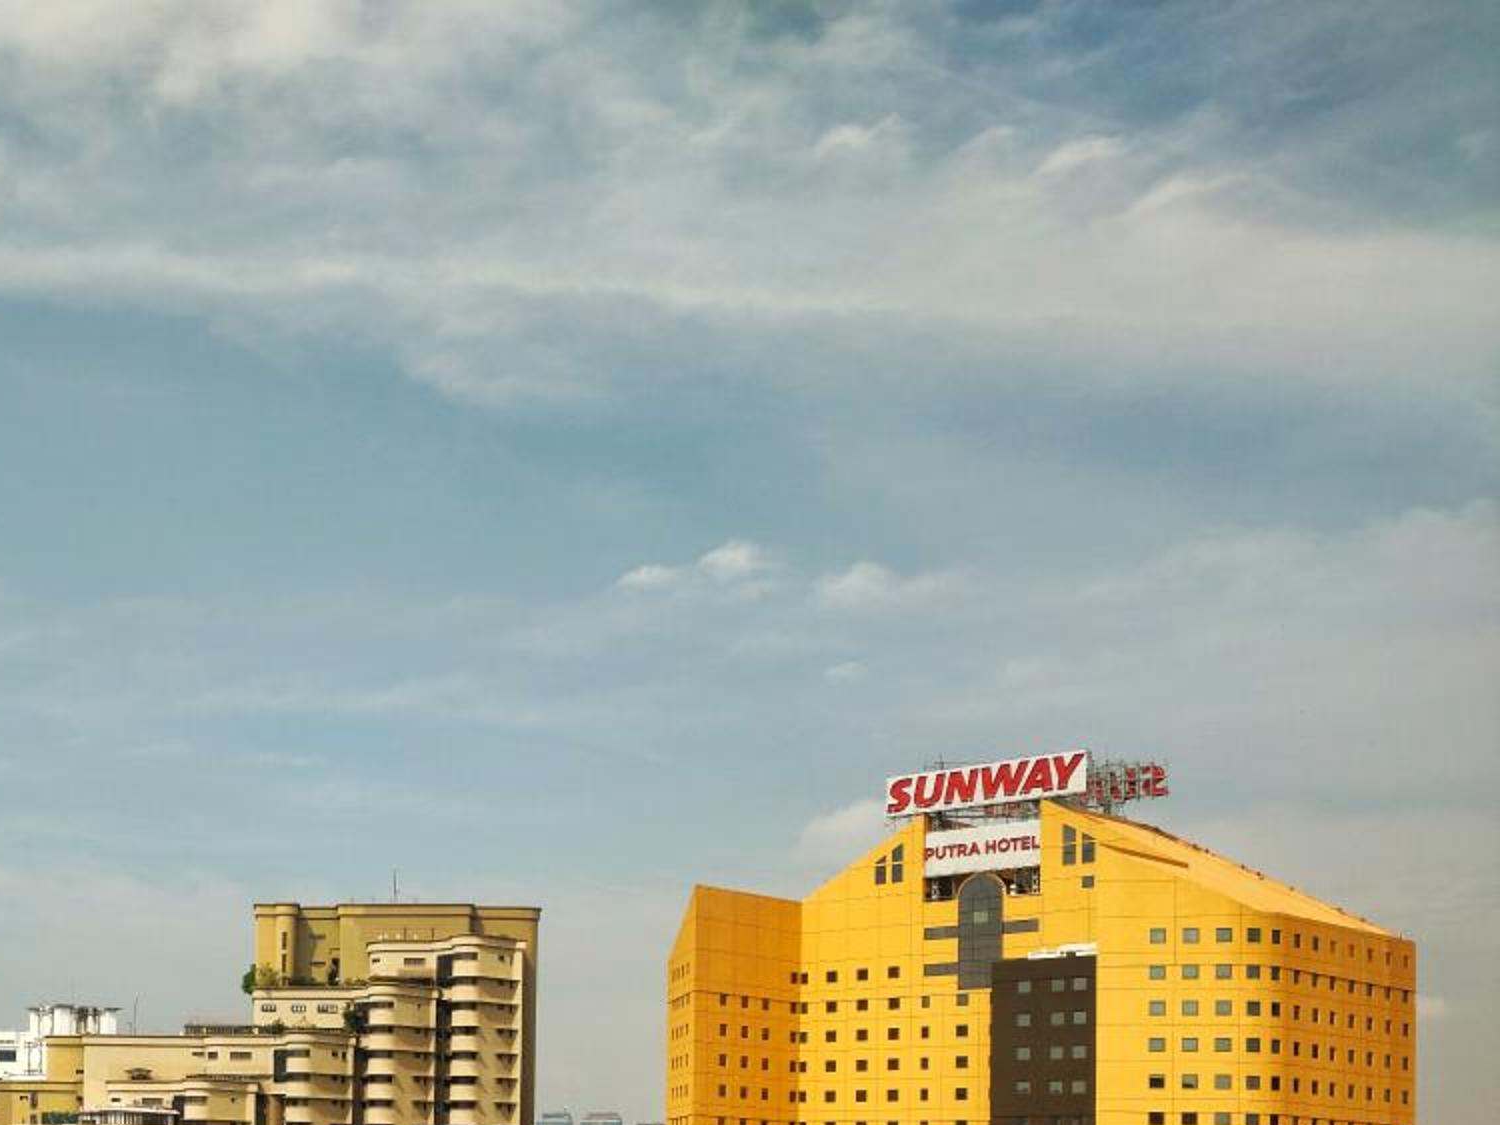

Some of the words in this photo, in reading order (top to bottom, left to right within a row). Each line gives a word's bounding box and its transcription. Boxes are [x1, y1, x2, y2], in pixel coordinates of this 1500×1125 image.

[887, 753, 1085, 814] SUNWAY
[925, 842, 980, 861] PUTRA
[985, 836, 1040, 854] HOTEL
